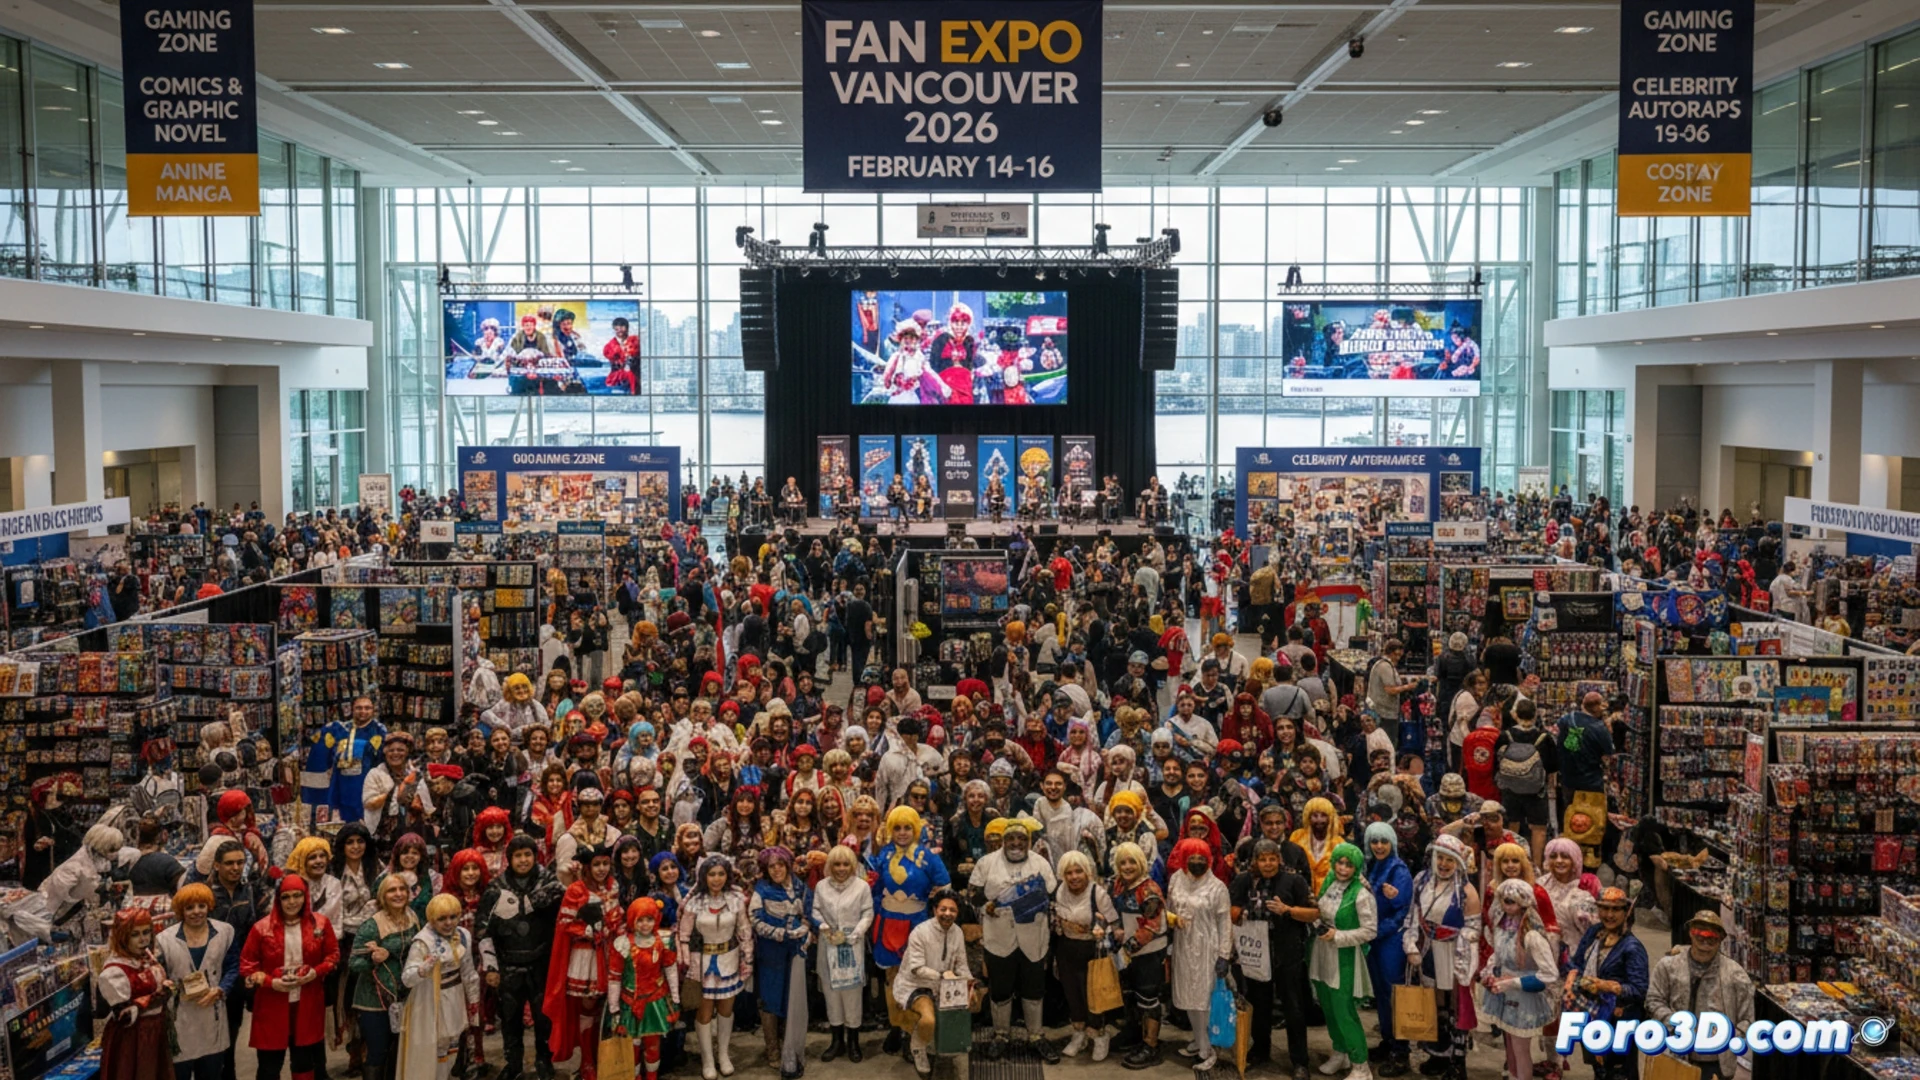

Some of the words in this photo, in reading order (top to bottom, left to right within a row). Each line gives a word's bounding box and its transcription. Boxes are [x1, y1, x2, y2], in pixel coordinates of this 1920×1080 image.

[144, 10, 231, 29] GAMING
[1644, 10, 1733, 29] GAMING
[158, 33, 218, 52] ZONE
[825, 20, 926, 63] FAN
[941, 20, 1083, 64] EXPO
[1657, 33, 1717, 52] ZONE
[140, 77, 223, 95] COMICS
[228, 77, 243, 95] &
[829, 71, 1079, 105] VANCOUVER
[1633, 77, 1738, 95] CELEBRITY
[143, 100, 239, 119] GRAPHIC
[1628, 100, 1741, 119] AUTORAPS
[154, 124, 226, 142] NOVEL
[904, 111, 999, 143] 2026
[848, 155, 980, 178] FEBRUARY
[986, 155, 1055, 179] 14-16
[156, 185, 232, 202] MANGA
[1658, 186, 1712, 202] ZONE
